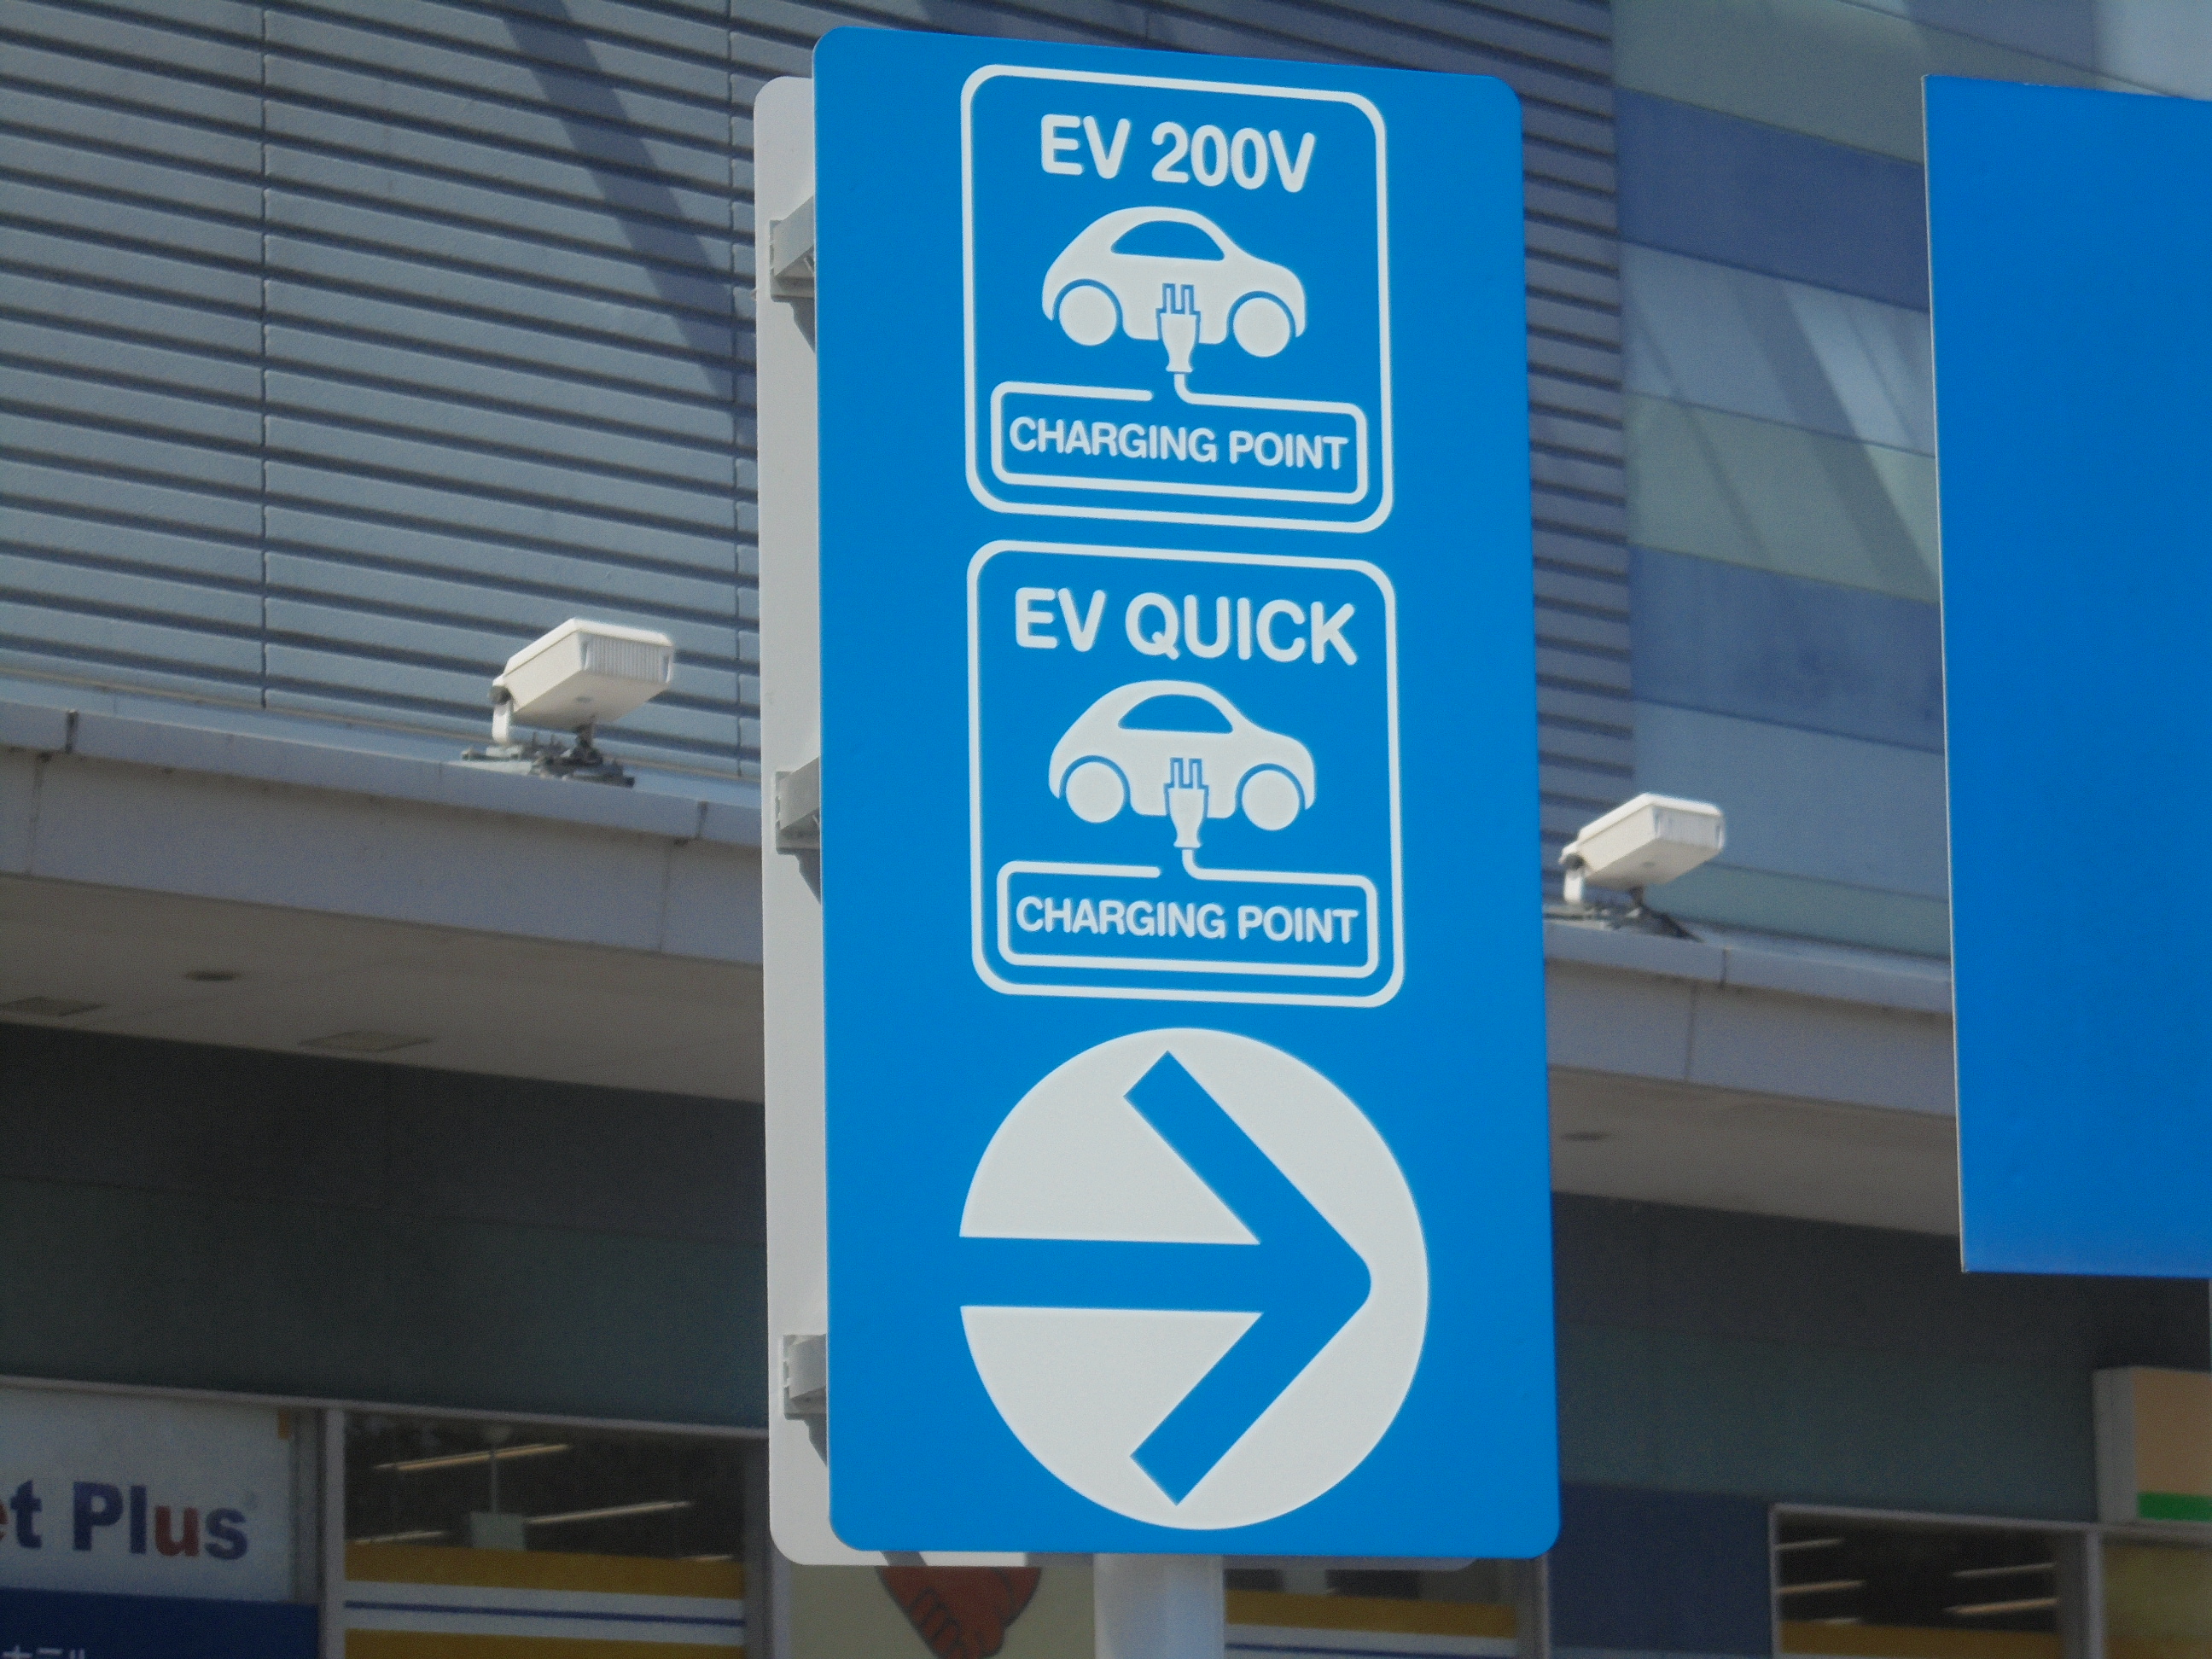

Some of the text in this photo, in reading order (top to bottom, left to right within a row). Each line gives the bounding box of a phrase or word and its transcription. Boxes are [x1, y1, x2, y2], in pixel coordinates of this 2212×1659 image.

[1041, 114, 1315, 193] EV 200V
[1010, 416, 1348, 470] CHARGING POINT
[1015, 586, 1358, 666] EV QUICK
[1016, 896, 1359, 944] CHARGING POINT
[73, 1481, 248, 1560] Plus
